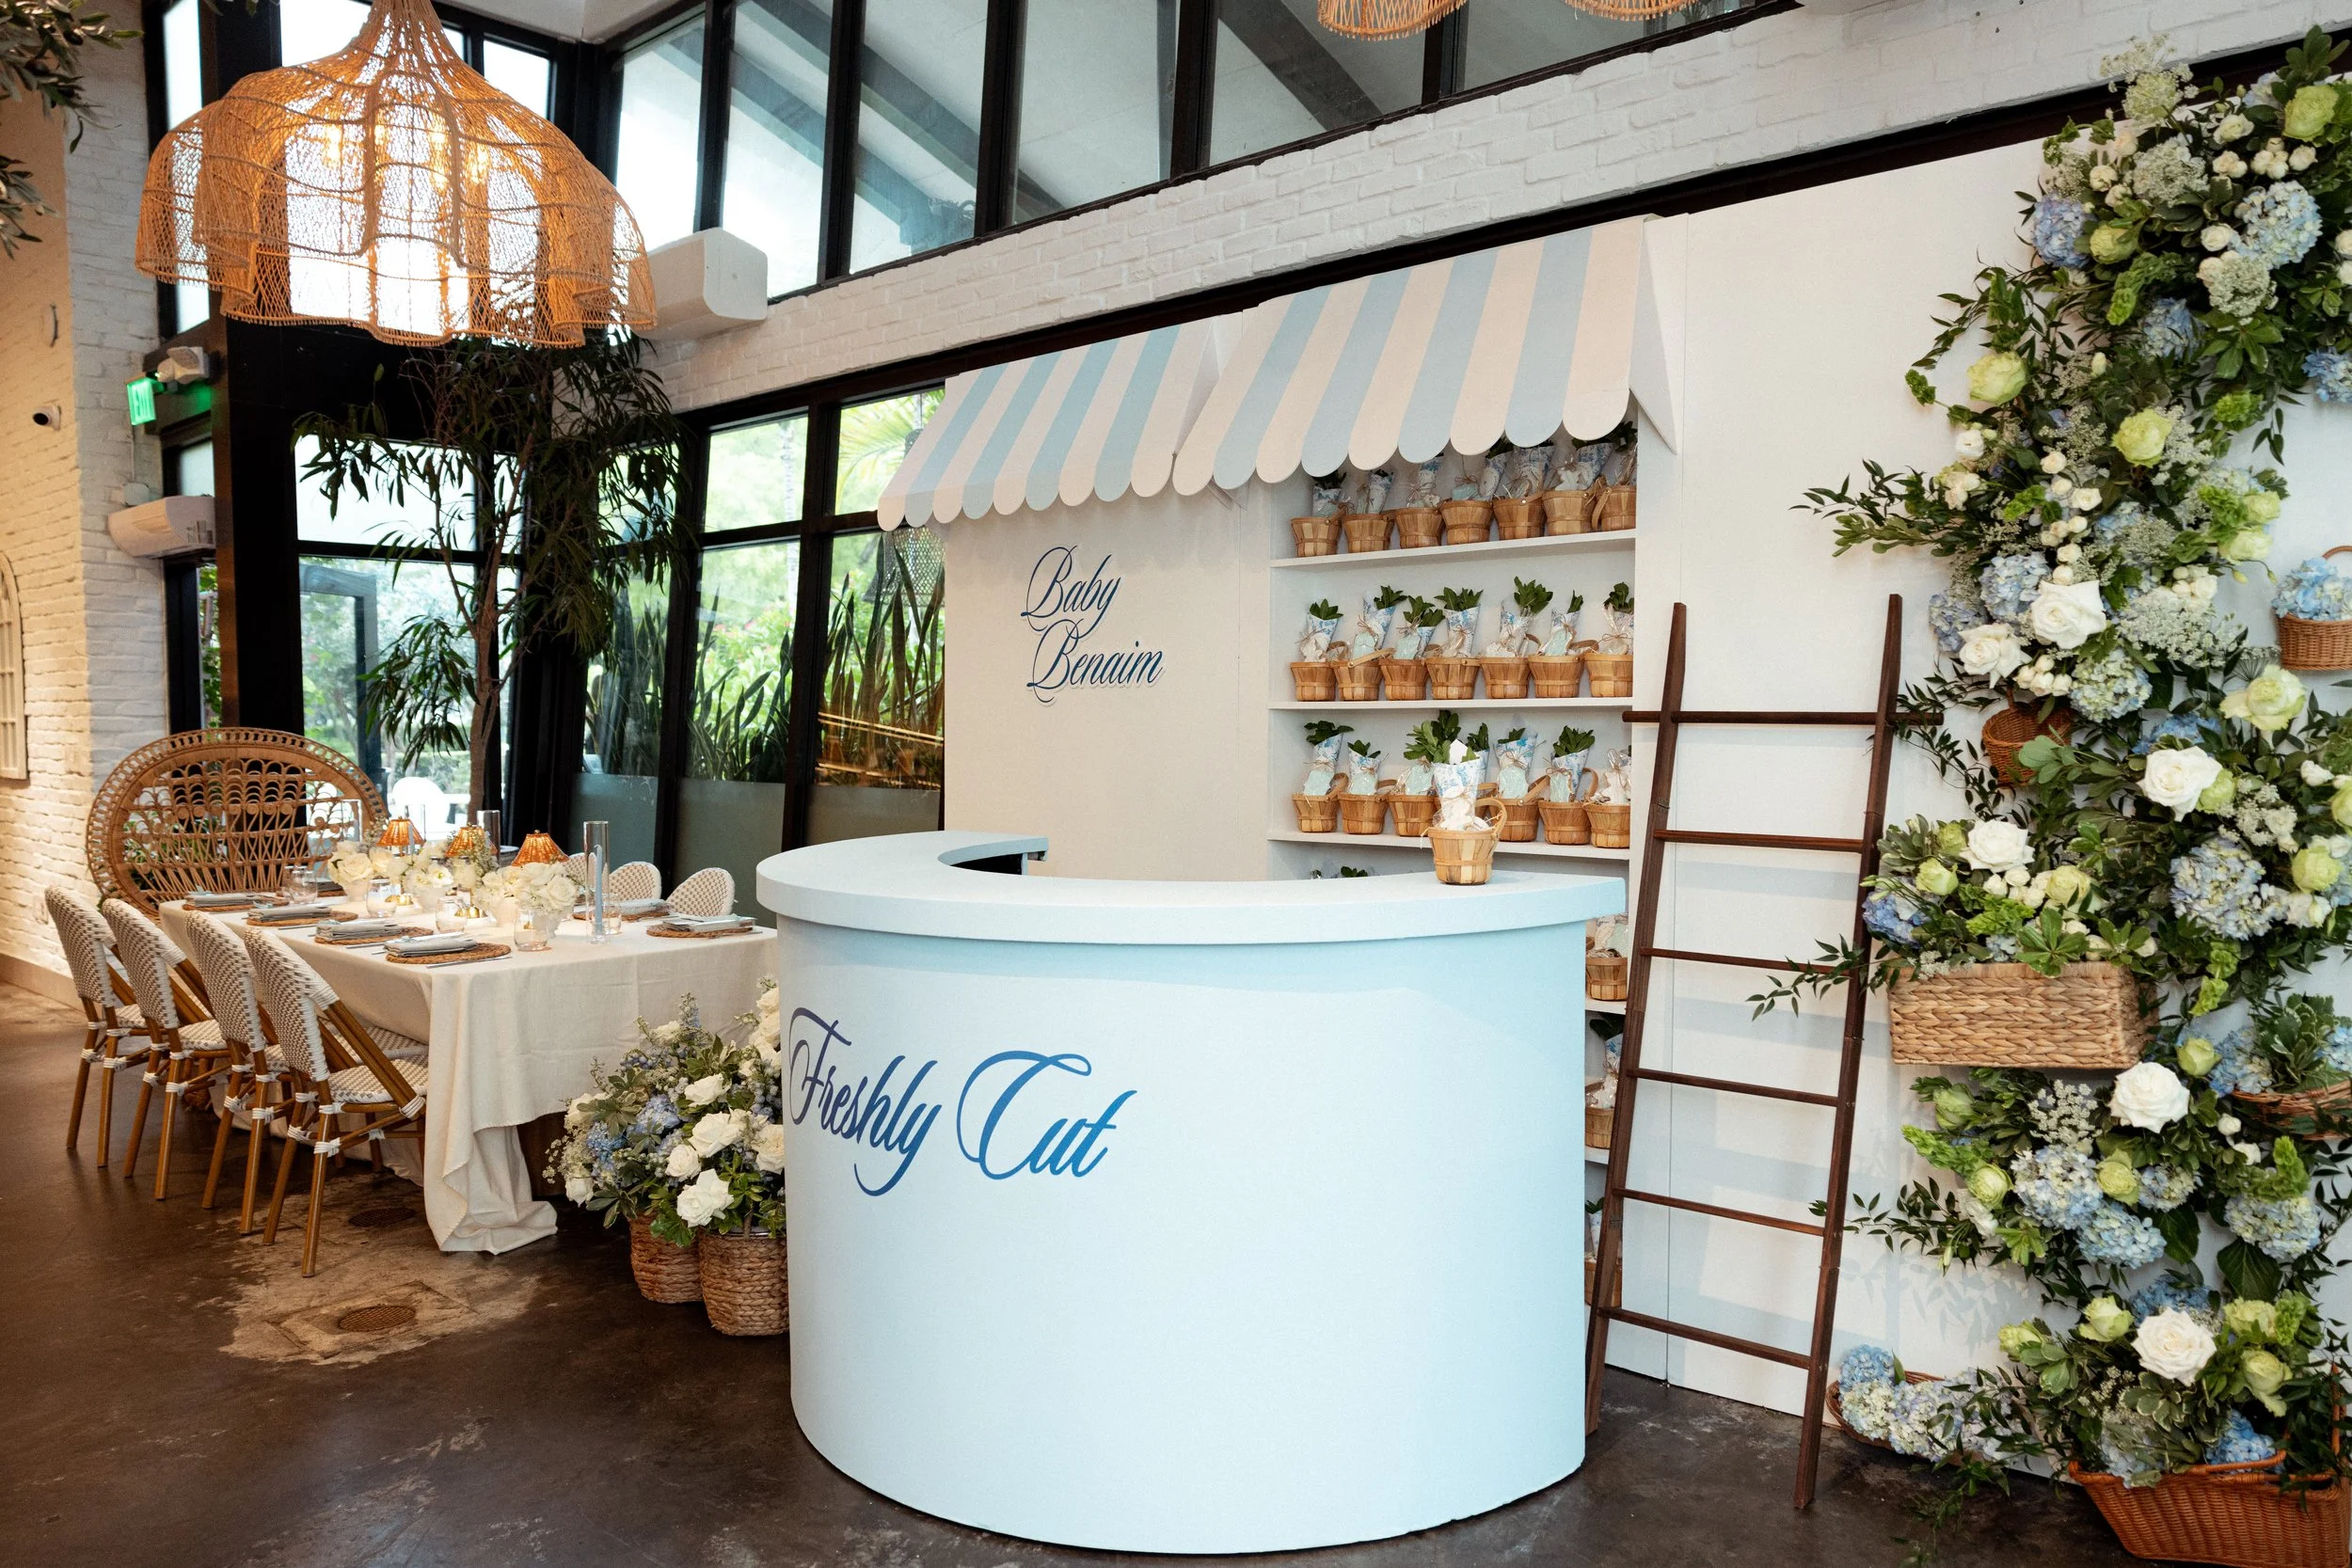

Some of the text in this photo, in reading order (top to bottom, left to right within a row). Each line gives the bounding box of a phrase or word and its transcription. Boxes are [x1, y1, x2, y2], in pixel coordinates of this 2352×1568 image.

[1021, 545, 1120, 640] Baby
[1026, 618, 1163, 703] Benaim
[788, 1006, 1137, 1196] Freshly Cut
